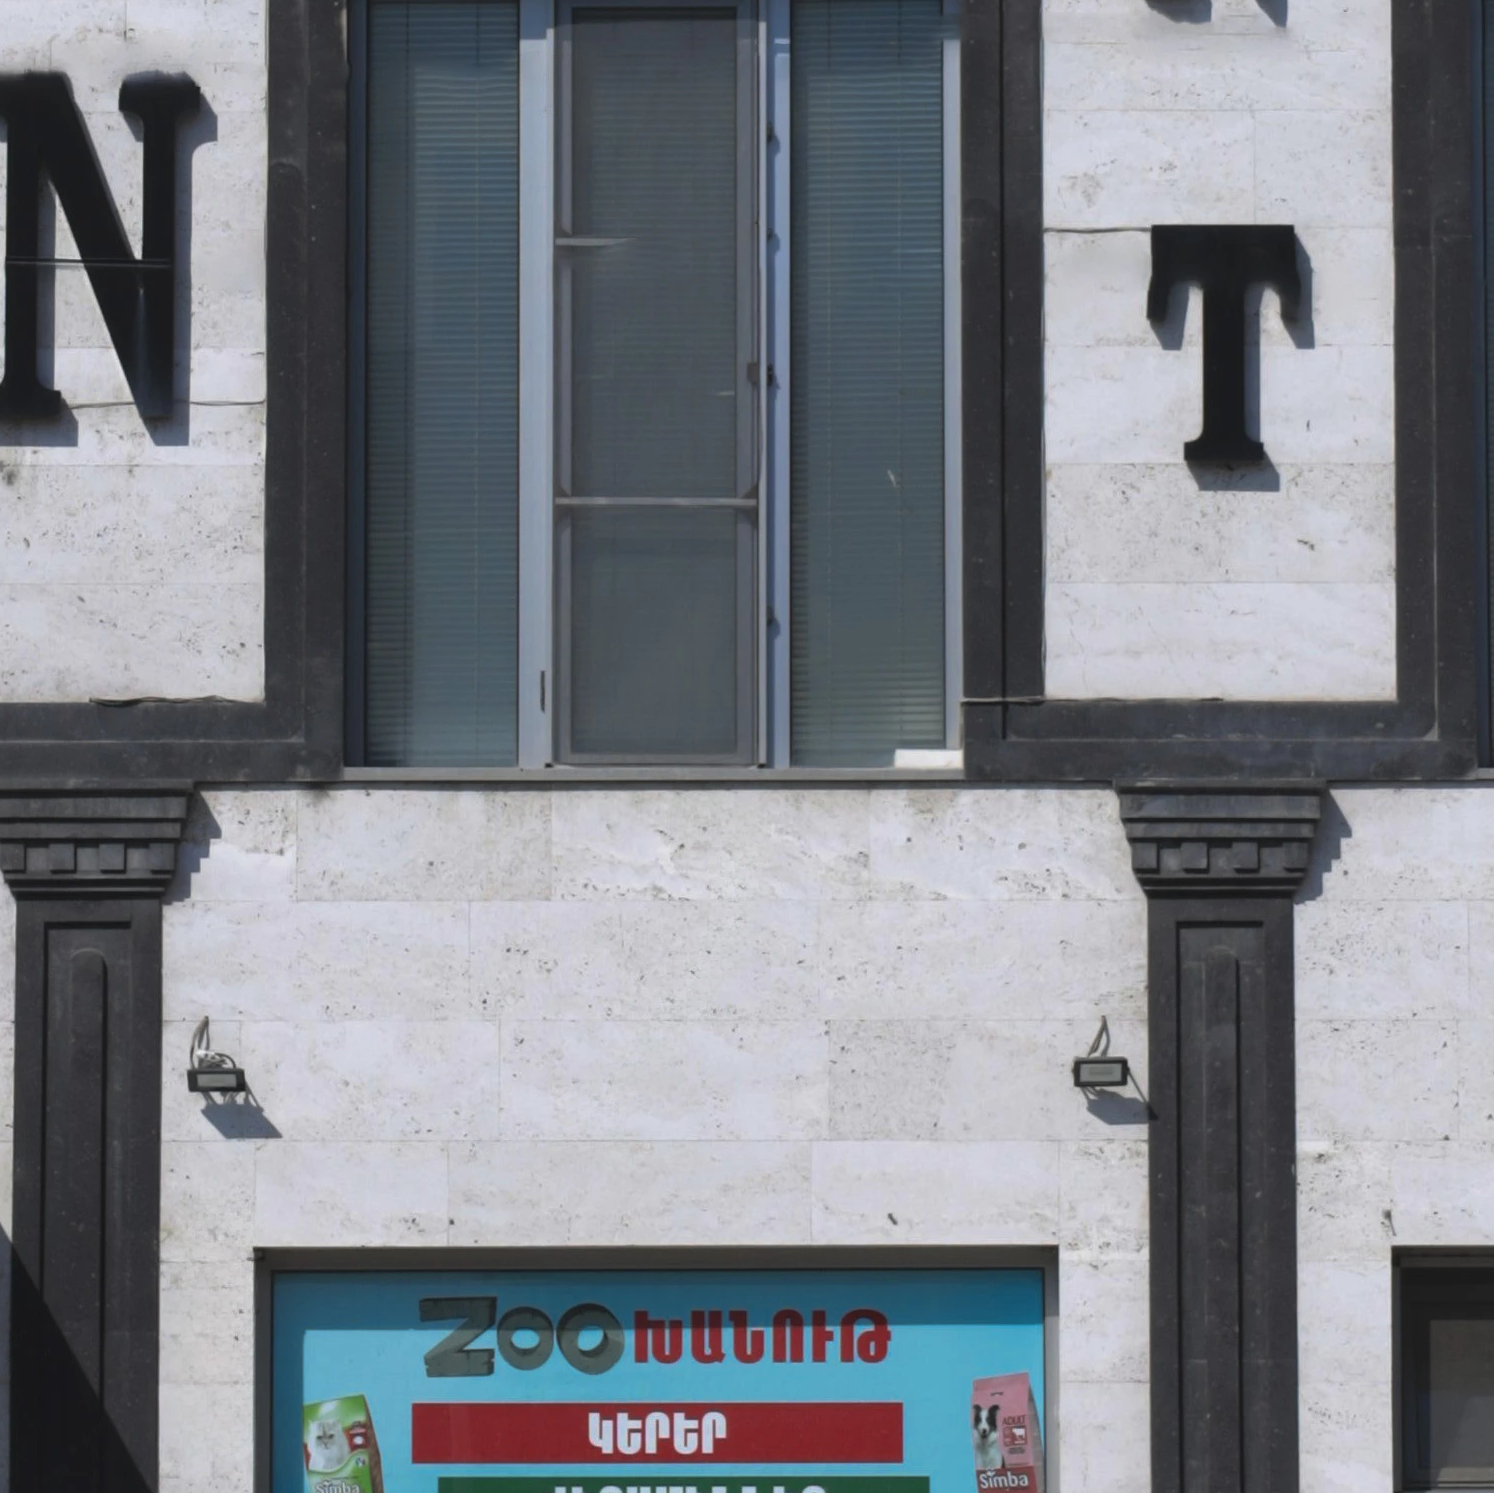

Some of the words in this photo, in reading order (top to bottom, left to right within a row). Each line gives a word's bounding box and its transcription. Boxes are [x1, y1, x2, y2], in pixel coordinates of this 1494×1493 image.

[633, 1309, 893, 1364] ԽԱՆՈՒԹ
[588, 1411, 728, 1455] ԿԵՐԵՐ
[979, 1471, 1029, 1489] Simba
